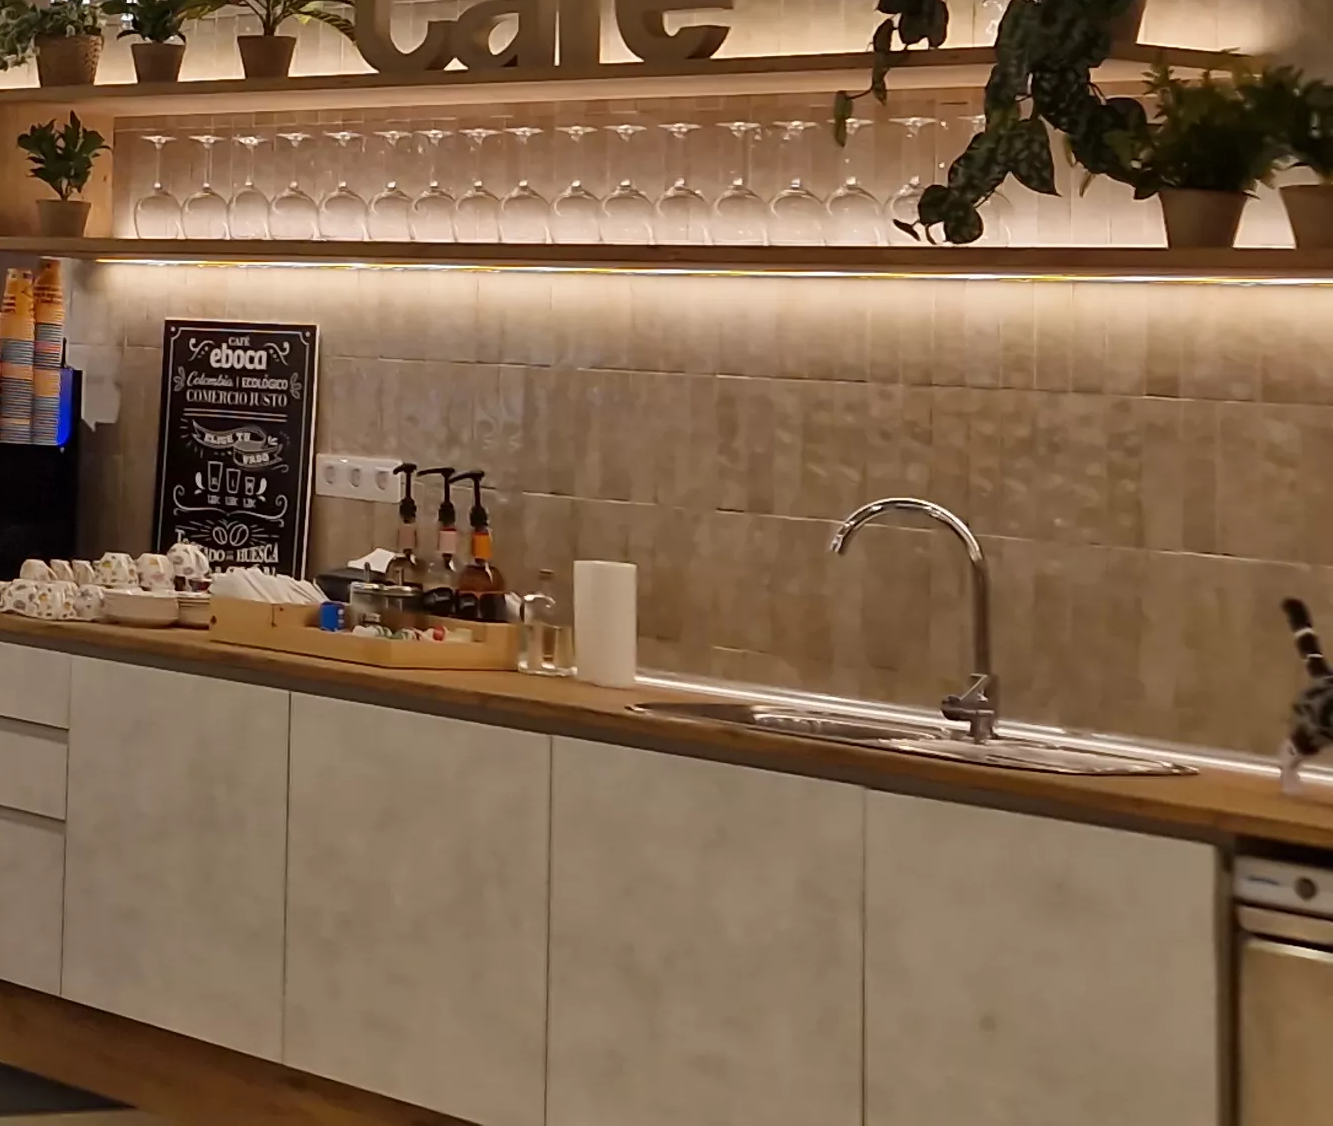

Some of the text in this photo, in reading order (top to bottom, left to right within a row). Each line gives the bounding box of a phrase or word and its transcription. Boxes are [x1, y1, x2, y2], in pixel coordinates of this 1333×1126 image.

[209, 342, 267, 370] eboca
[186, 388, 288, 408] COMERCIO JUSTO
[236, 541, 279, 564] HUESCA
